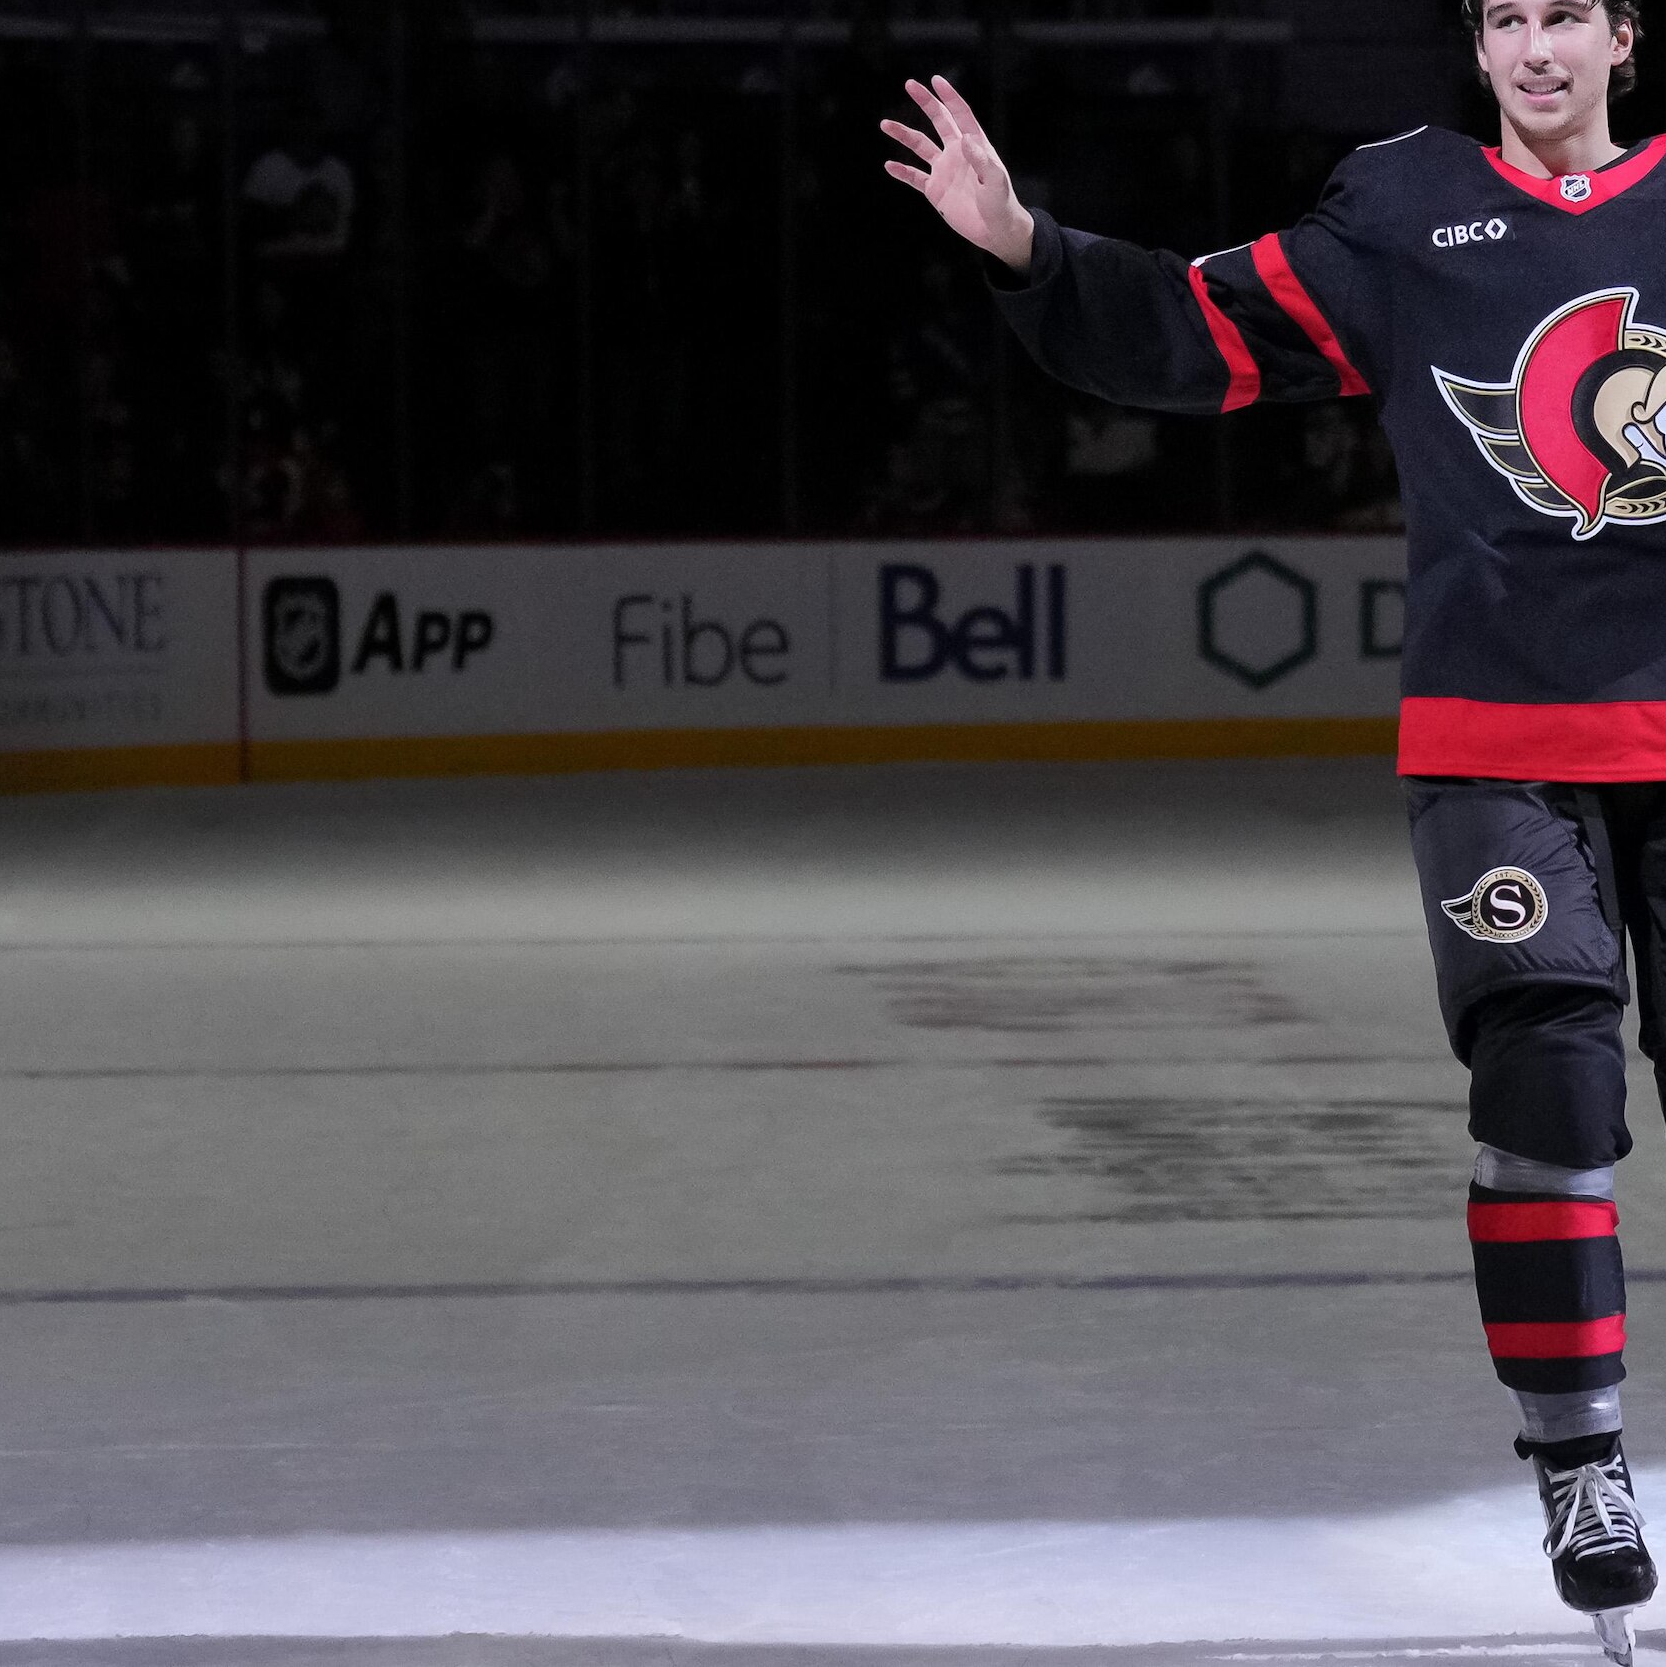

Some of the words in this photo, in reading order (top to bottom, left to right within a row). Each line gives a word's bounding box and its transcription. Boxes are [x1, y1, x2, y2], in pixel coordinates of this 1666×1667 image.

[1432, 221, 1484, 248] CIBC
[613, 592, 789, 687] Fibe
[878, 561, 1066, 683] Bell
[1490, 885, 1526, 927] S
